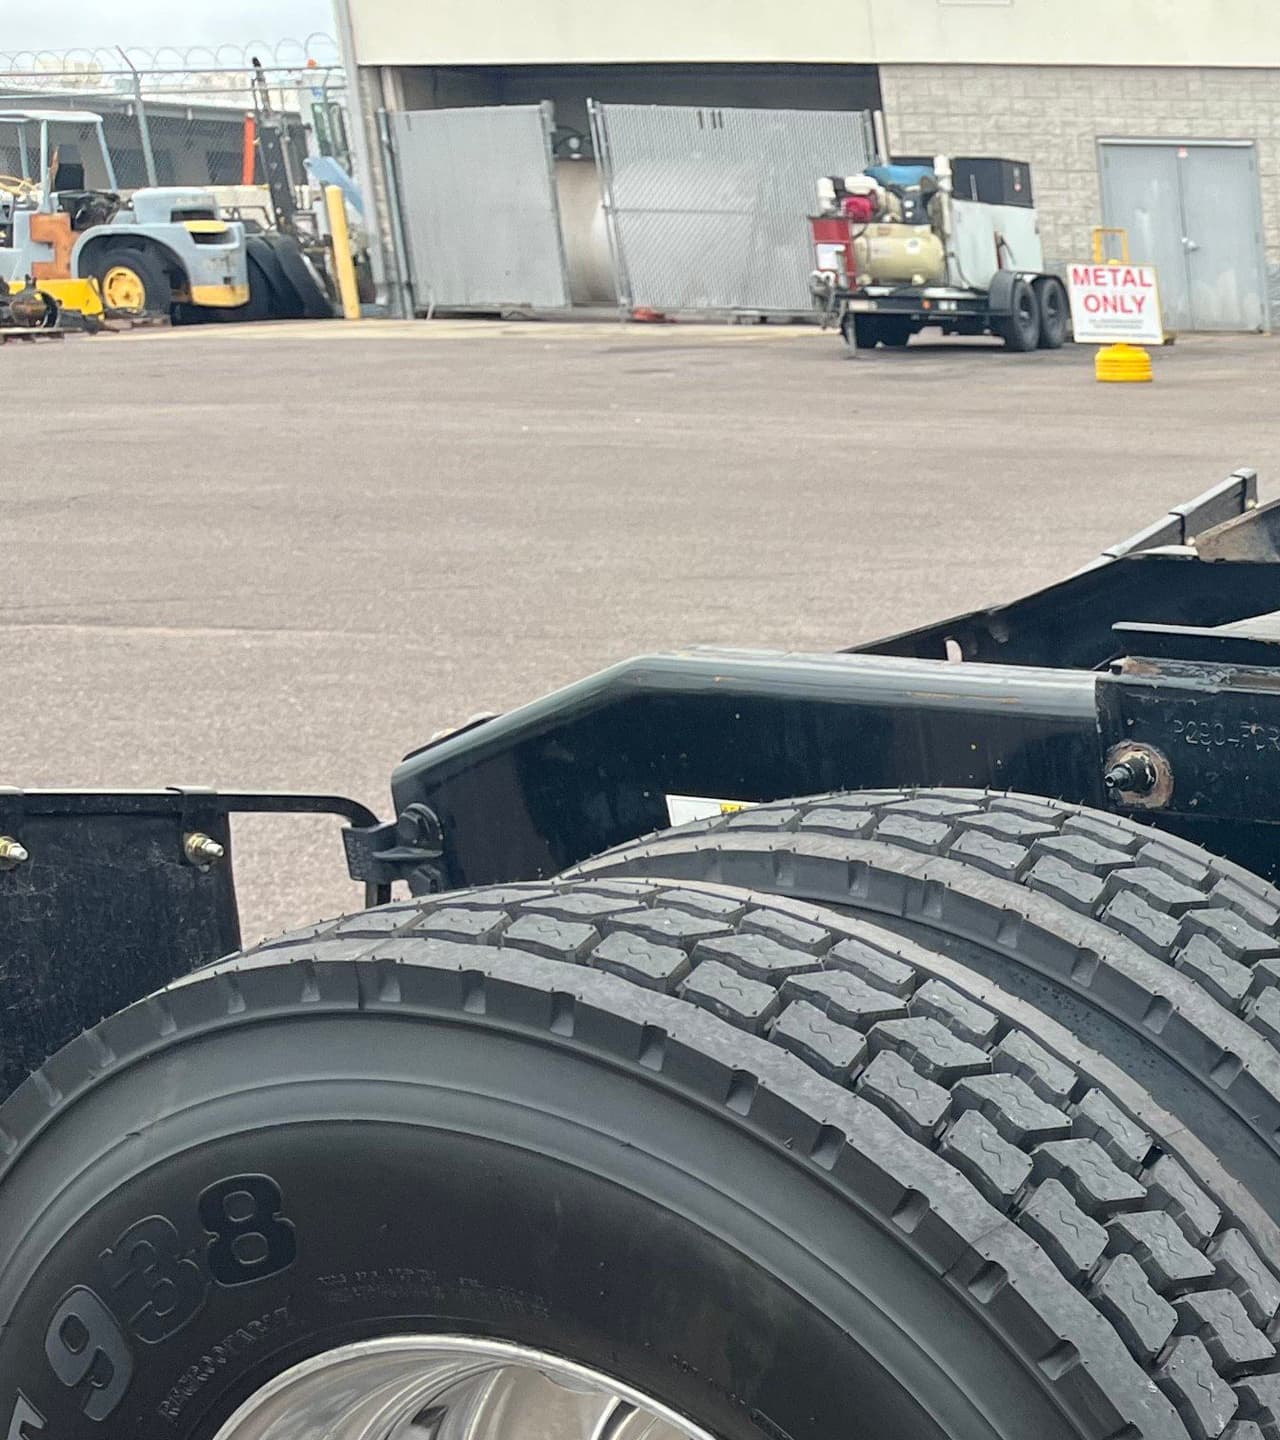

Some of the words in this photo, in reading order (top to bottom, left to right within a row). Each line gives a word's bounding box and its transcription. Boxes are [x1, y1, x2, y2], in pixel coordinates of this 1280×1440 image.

[1072, 268, 1153, 287] METAL
[1084, 294, 1146, 313] ONLY
[44, 1172, 298, 1422] 938
